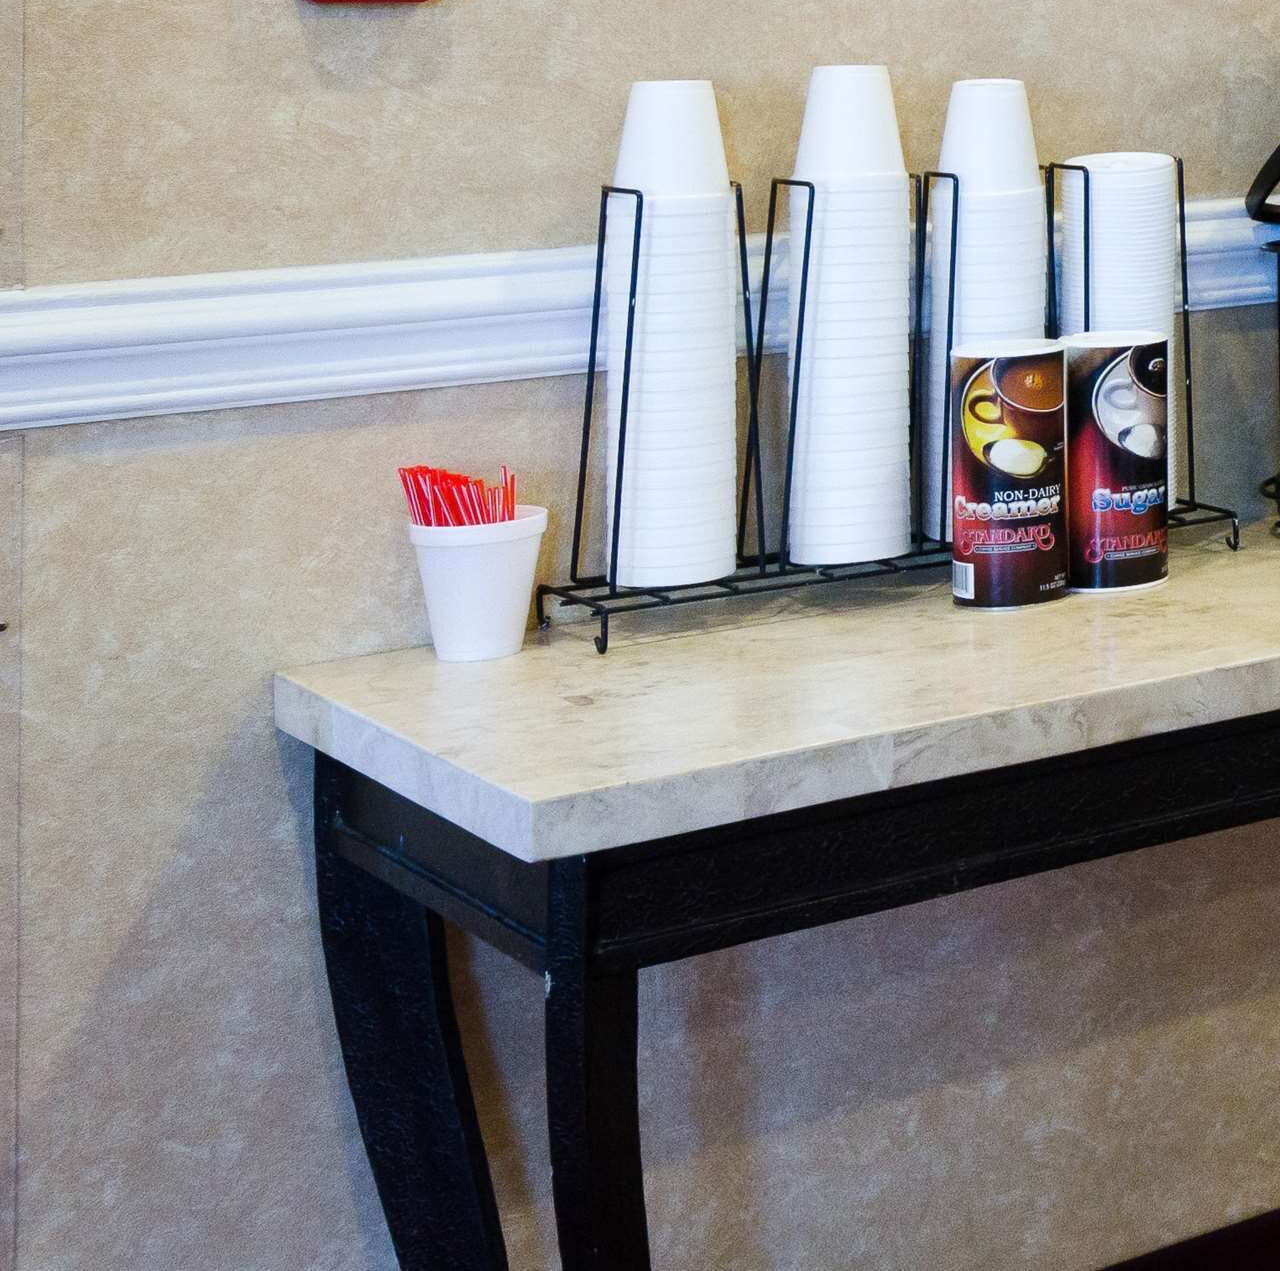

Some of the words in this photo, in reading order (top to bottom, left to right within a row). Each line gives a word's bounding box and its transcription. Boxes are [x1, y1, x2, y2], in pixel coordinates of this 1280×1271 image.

[994, 484, 1061, 501] NON-DAIRY
[955, 495, 1061, 521] Creamer
[959, 523, 1056, 556] STANDARD
